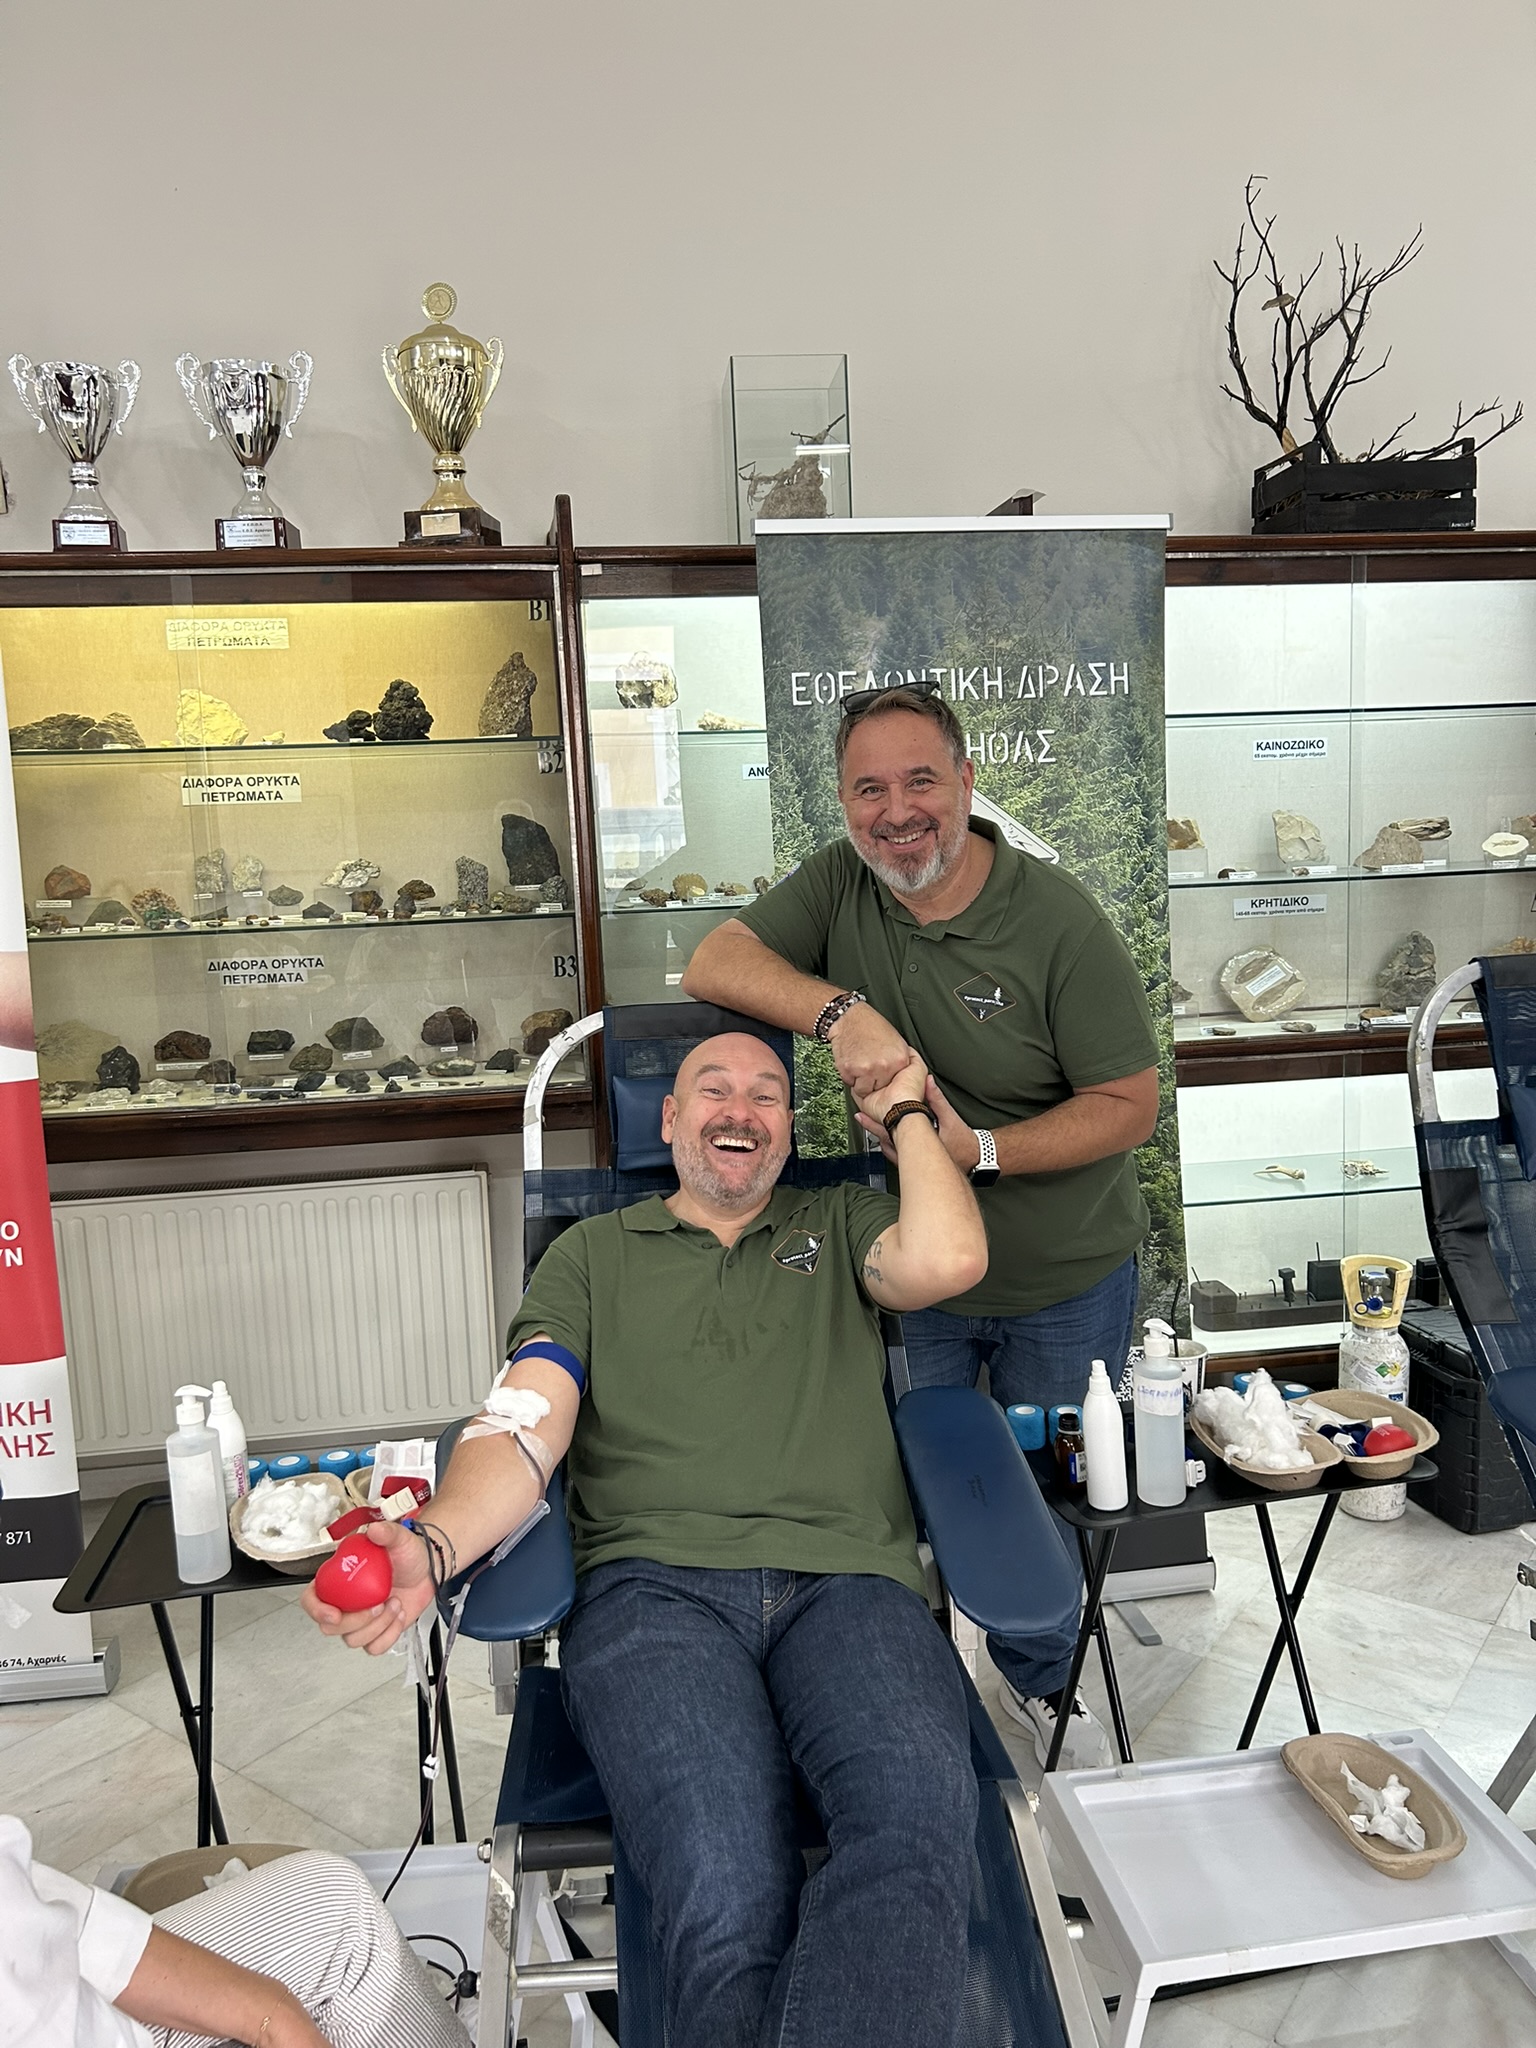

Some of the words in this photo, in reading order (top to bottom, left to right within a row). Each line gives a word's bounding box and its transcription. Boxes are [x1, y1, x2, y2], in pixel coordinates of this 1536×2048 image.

[168, 621, 230, 632] ΔΙΑΦΟΡΑ
[233, 620, 287, 632] ΟΡΥΚΤΑ
[187, 637, 270, 647] ΠΕΤΡΩΜΑΤΑ
[1017, 662, 1130, 699] ΔΡΑΣΗ
[966, 729, 1057, 765] ΗΘΑΣ
[1256, 739, 1325, 751] ΚΑΙΝΟΖΩΙΚΟ
[182, 776, 243, 789] ΔΙΑΦΟΡΑ
[246, 775, 300, 787] ΟΡΥΚΤΑ
[201, 790, 283, 803] ΠΕΤΡΩΜΑΤΑ
[1250, 896, 1309, 909] ΚΡΗΤΙΔΙΚΟ
[208, 959, 268, 972] ΔΙΑΦΟΡΑ
[271, 957, 325, 969] ΟΡΥΚΤΑ
[223, 972, 304, 985] ΠΕΤΡΩΜΑΤΑ
[5, 1530, 32, 1545] 871
[27, 1653, 67, 1667] Αχαρνές
